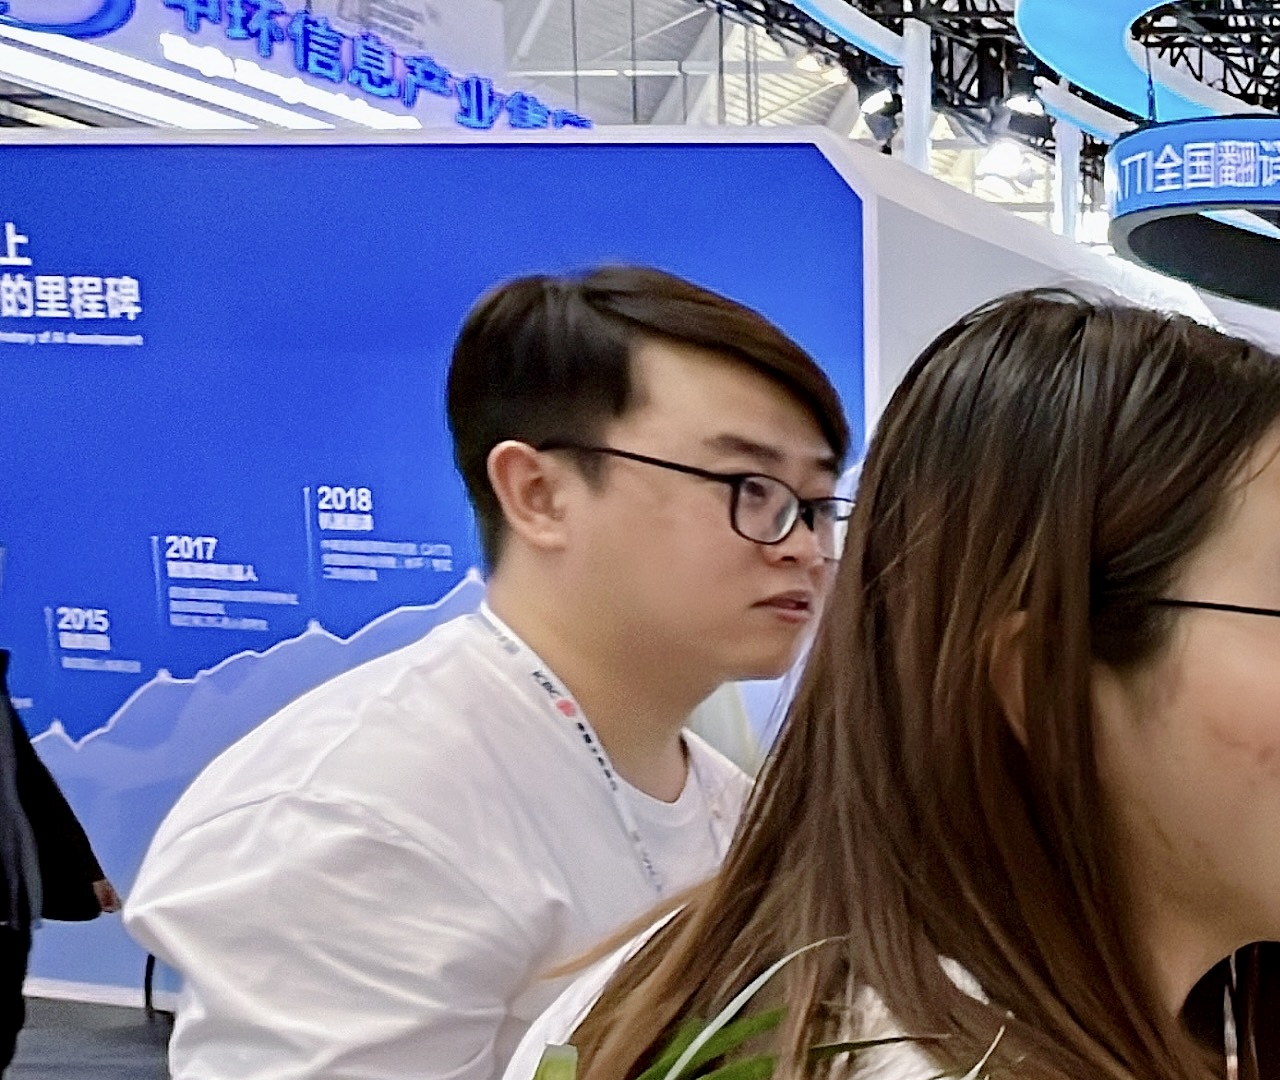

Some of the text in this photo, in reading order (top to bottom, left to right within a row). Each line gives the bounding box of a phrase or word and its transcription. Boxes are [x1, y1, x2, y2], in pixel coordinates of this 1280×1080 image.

[1, 272, 142, 321] 的里程碑
[317, 485, 372, 511] 2018
[165, 535, 218, 560] 2017
[56, 606, 109, 632] 2015
